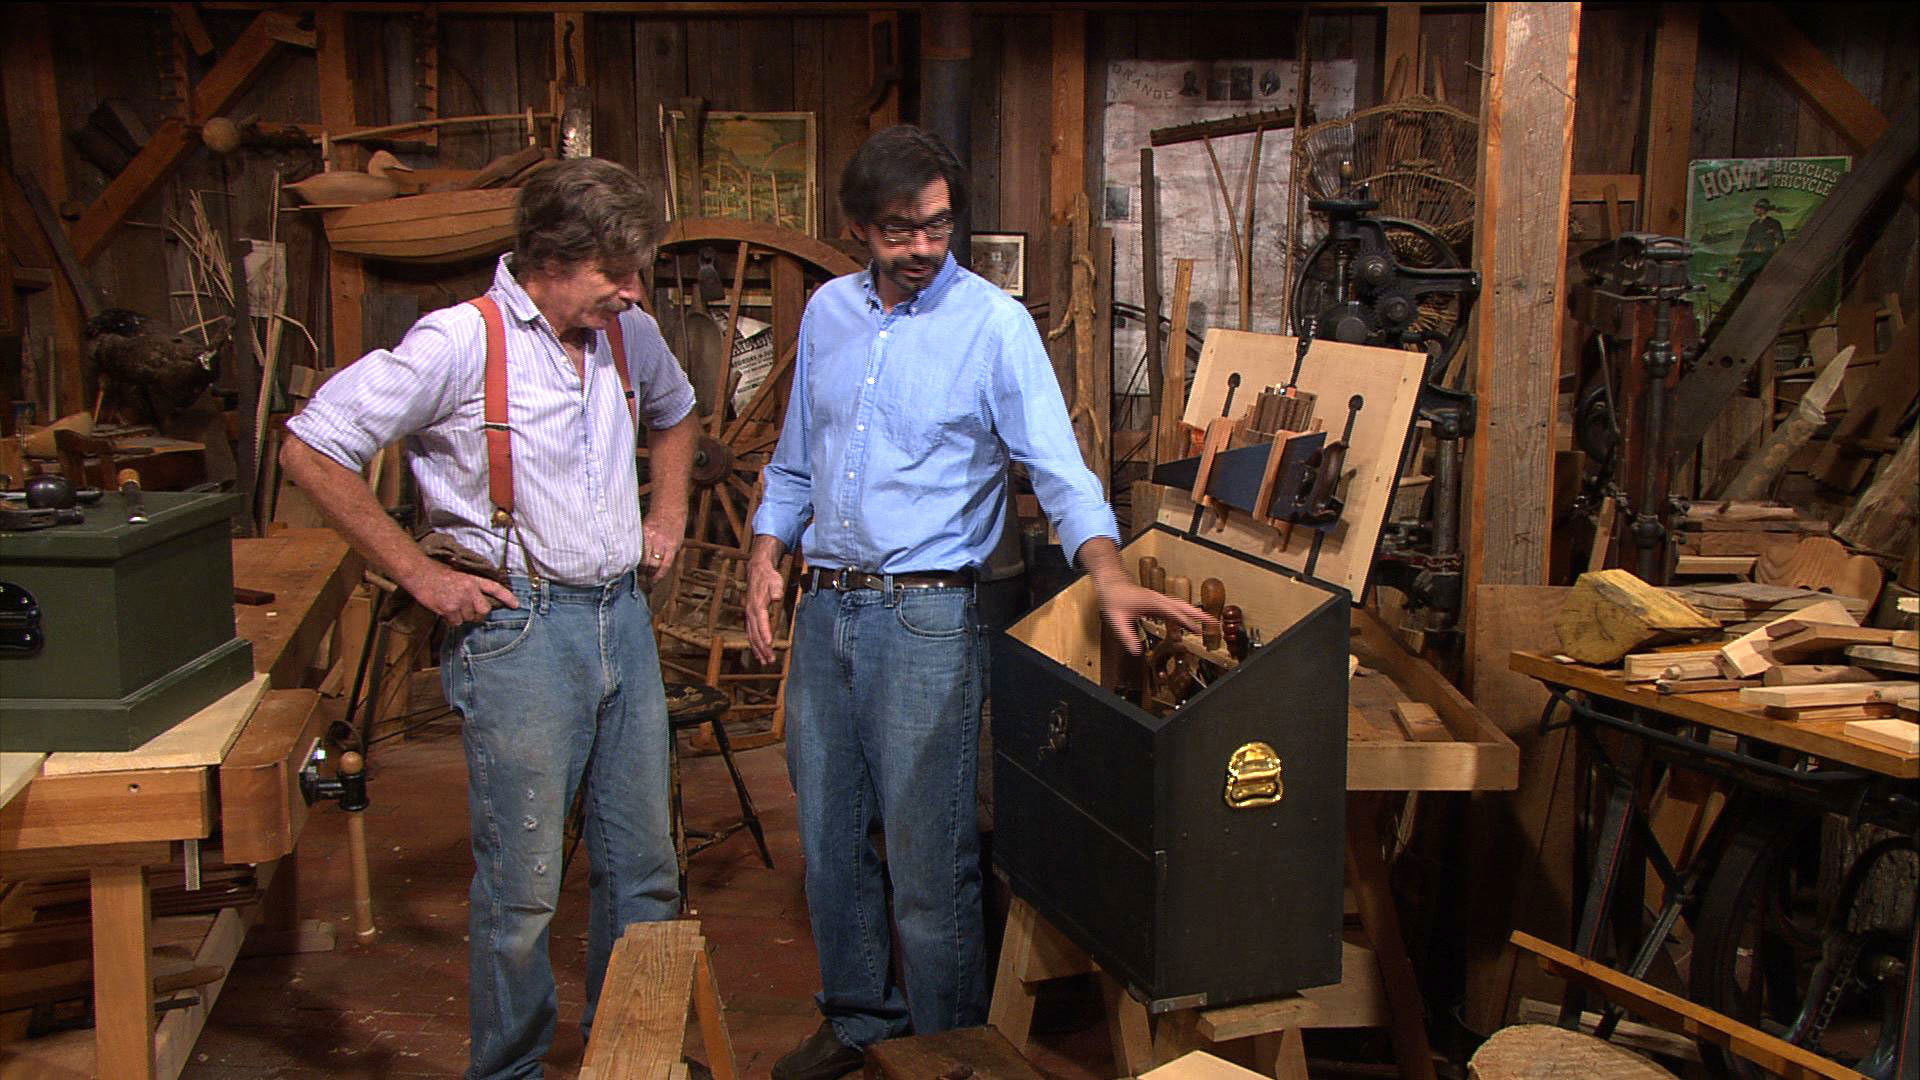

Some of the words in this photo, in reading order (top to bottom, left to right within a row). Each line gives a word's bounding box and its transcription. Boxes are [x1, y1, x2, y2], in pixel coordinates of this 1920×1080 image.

[1291, 63, 1352, 97] CUNTY
[1700, 159, 1769, 200] HOWE
[1774, 160, 1841, 183] BICYCLES
[1773, 174, 1834, 197] TRICYCLE
